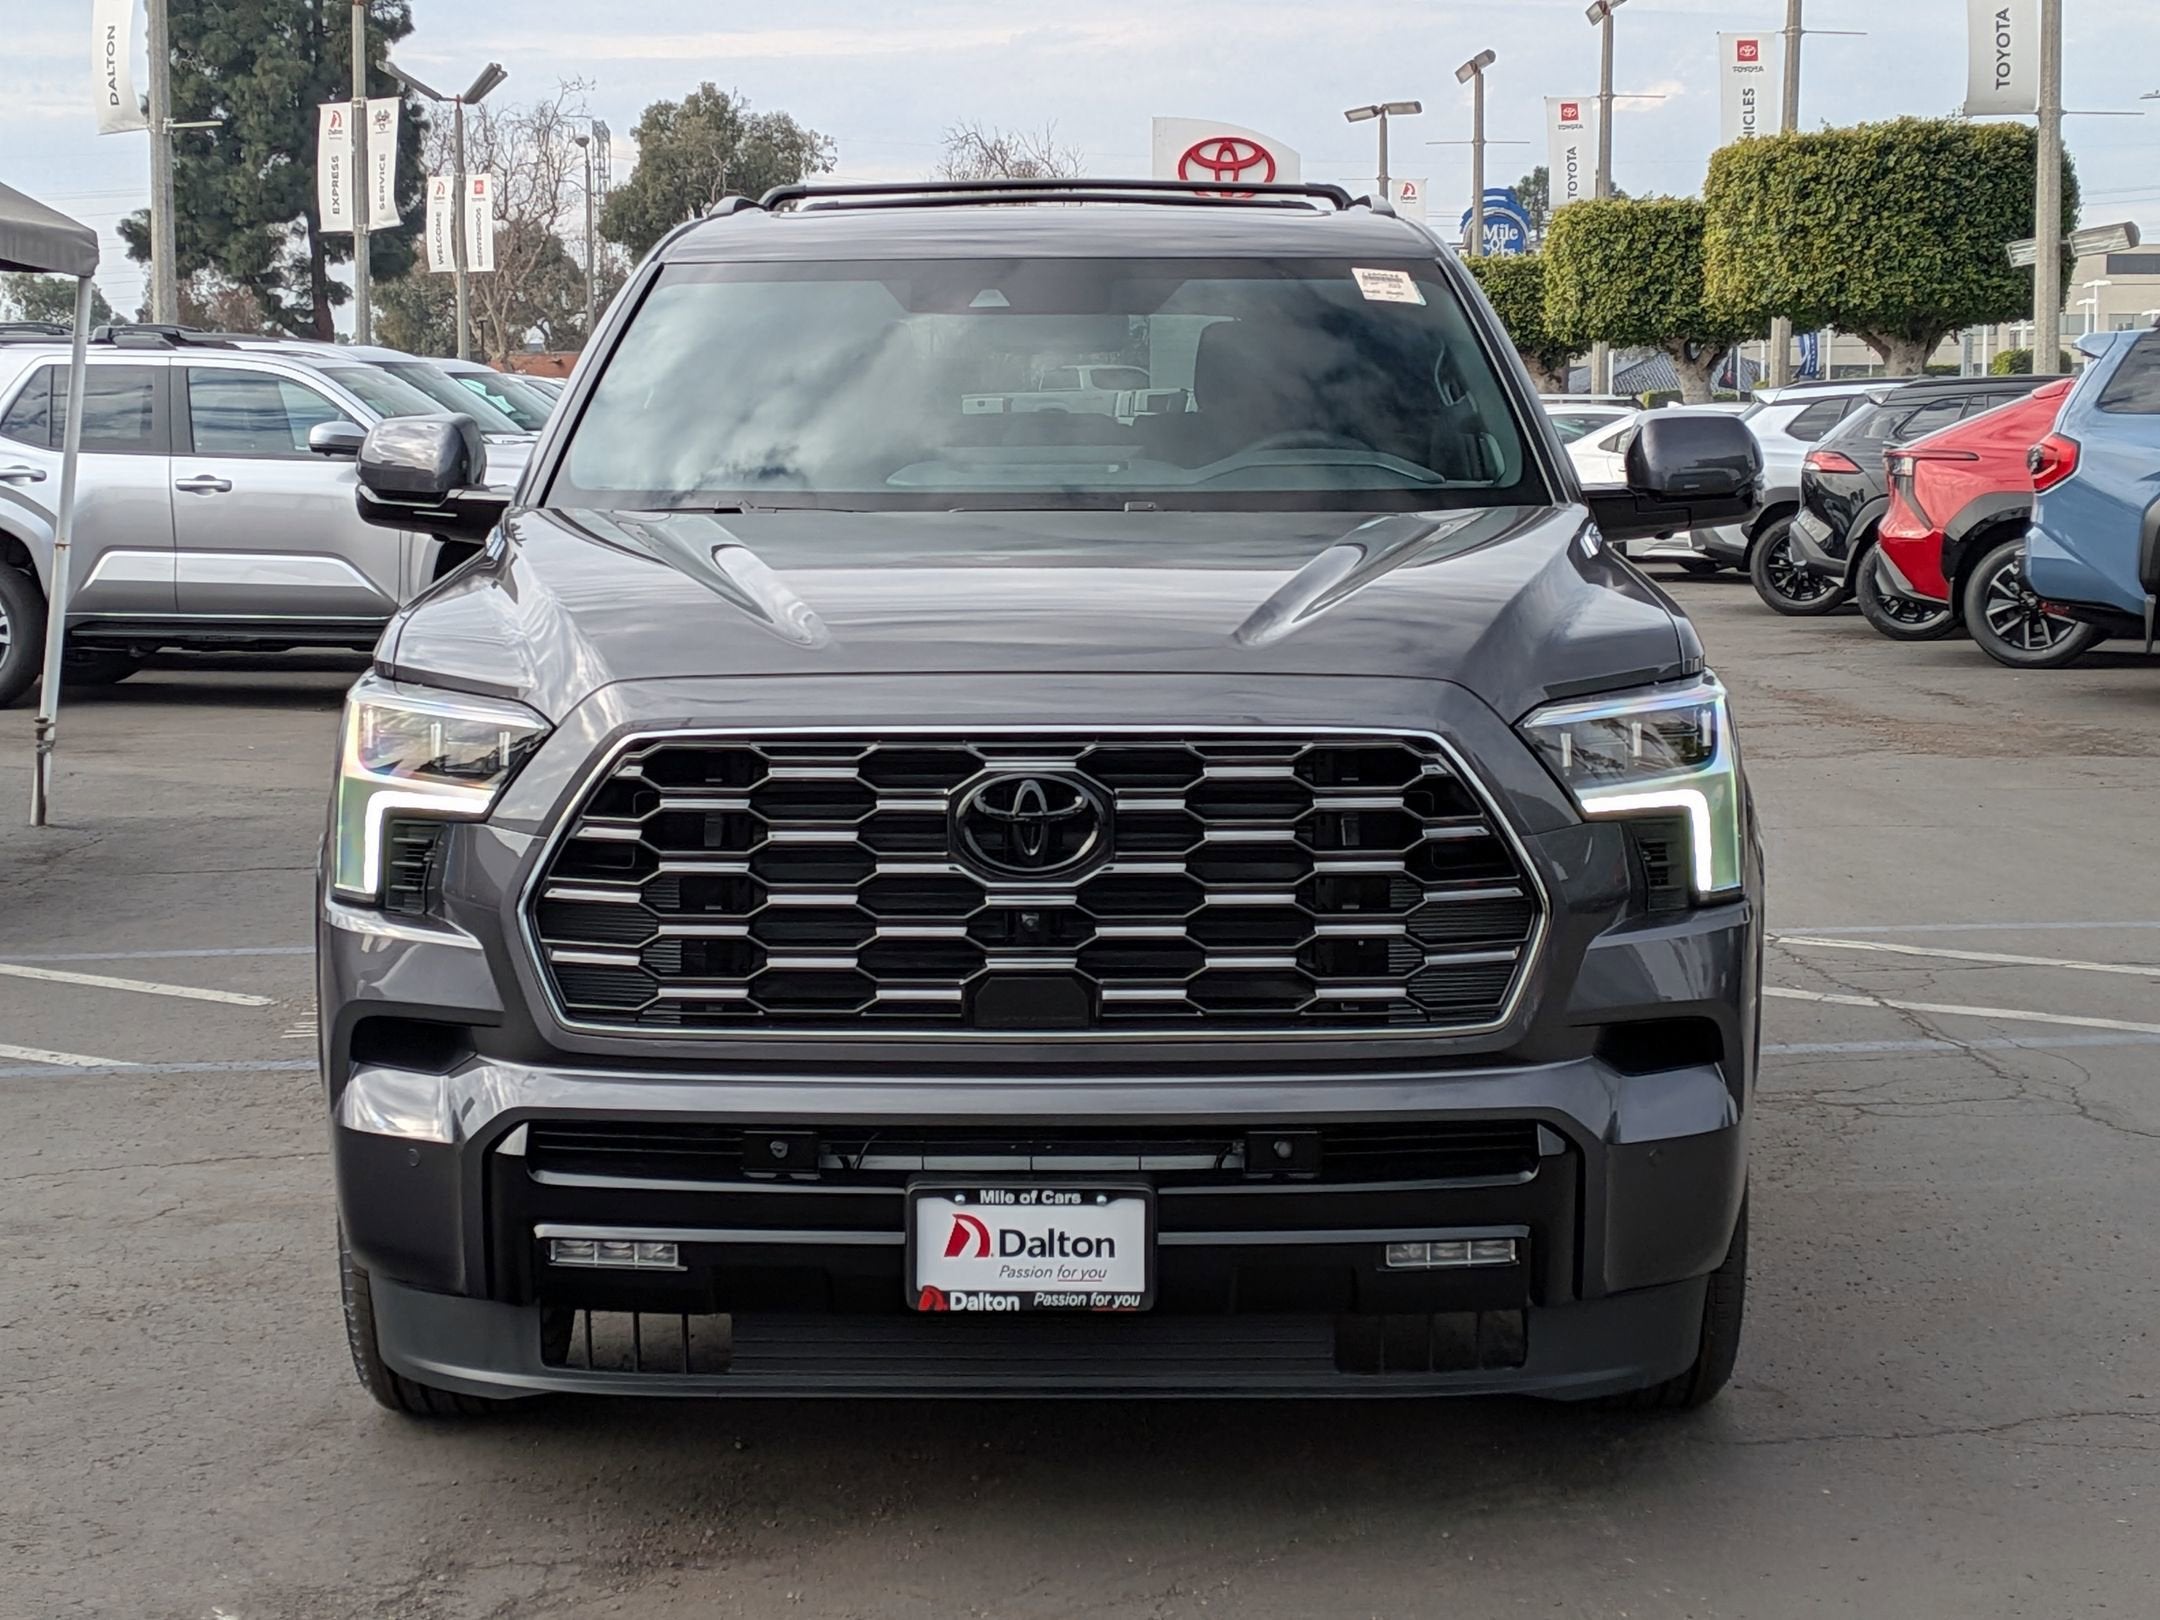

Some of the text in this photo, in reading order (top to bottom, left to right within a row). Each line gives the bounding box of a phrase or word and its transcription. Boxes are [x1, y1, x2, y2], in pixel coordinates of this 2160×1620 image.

[1995, 7, 2011, 91] TOYOTA
[106, 25, 120, 106] DALTON
[331, 155, 340, 215] EXPRESS
[1566, 145, 1578, 200] TOYOTA
[435, 211, 445, 265] WELCOME
[1483, 223, 1519, 241] Mile
[979, 1189, 1082, 1205] Mile of Cars
[999, 1228, 1116, 1258] Dalton
[999, 1264, 1108, 1281] Passion for you
[949, 1291, 1020, 1312] Dalton
[1033, 1292, 1141, 1309] Passion for you
